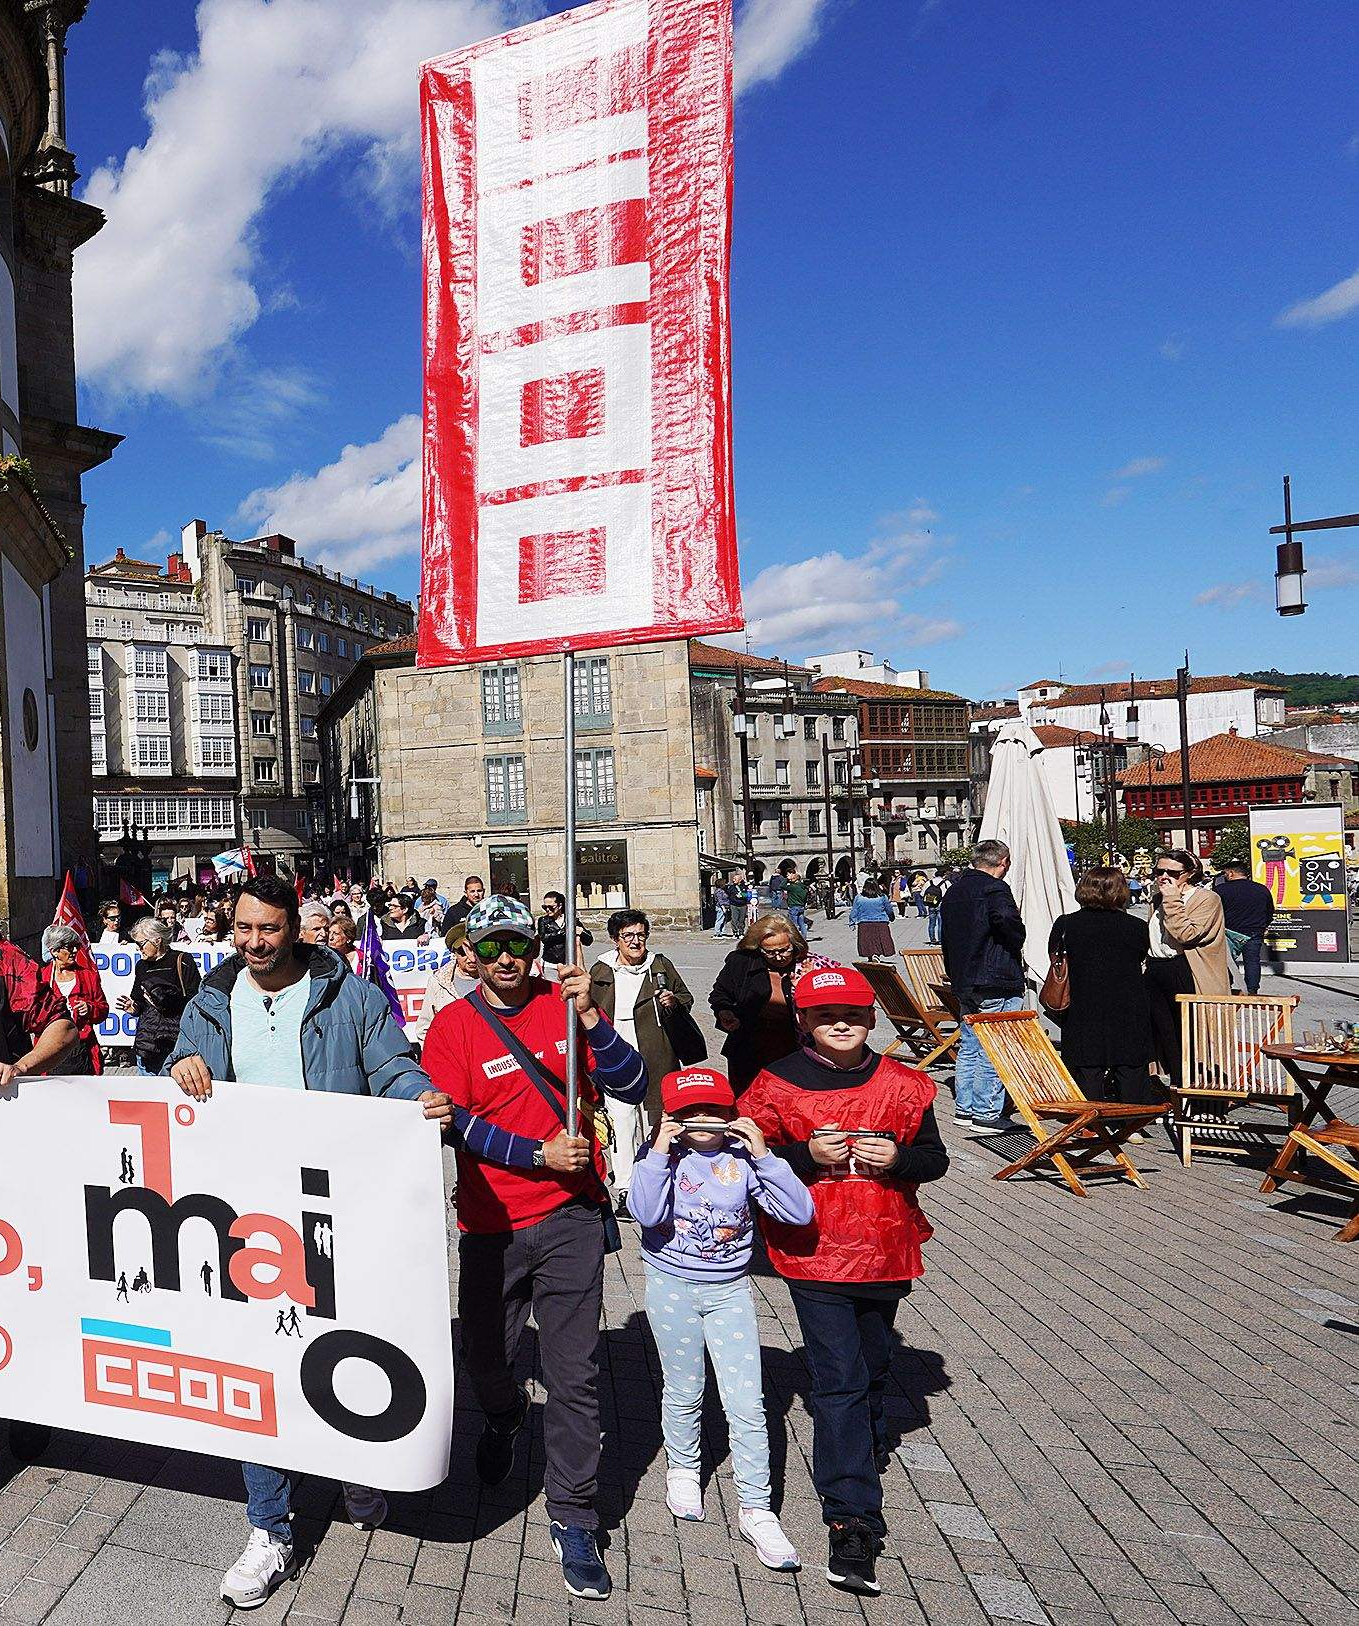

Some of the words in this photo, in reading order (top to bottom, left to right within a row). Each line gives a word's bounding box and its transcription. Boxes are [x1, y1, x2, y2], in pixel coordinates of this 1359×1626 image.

[473, 0, 655, 648] CCOO
[580, 853, 619, 864] salitre
[1305, 860, 1319, 871] O
[1305, 871, 1335, 882] SAL
[95, 1353, 263, 1422] CCOO
